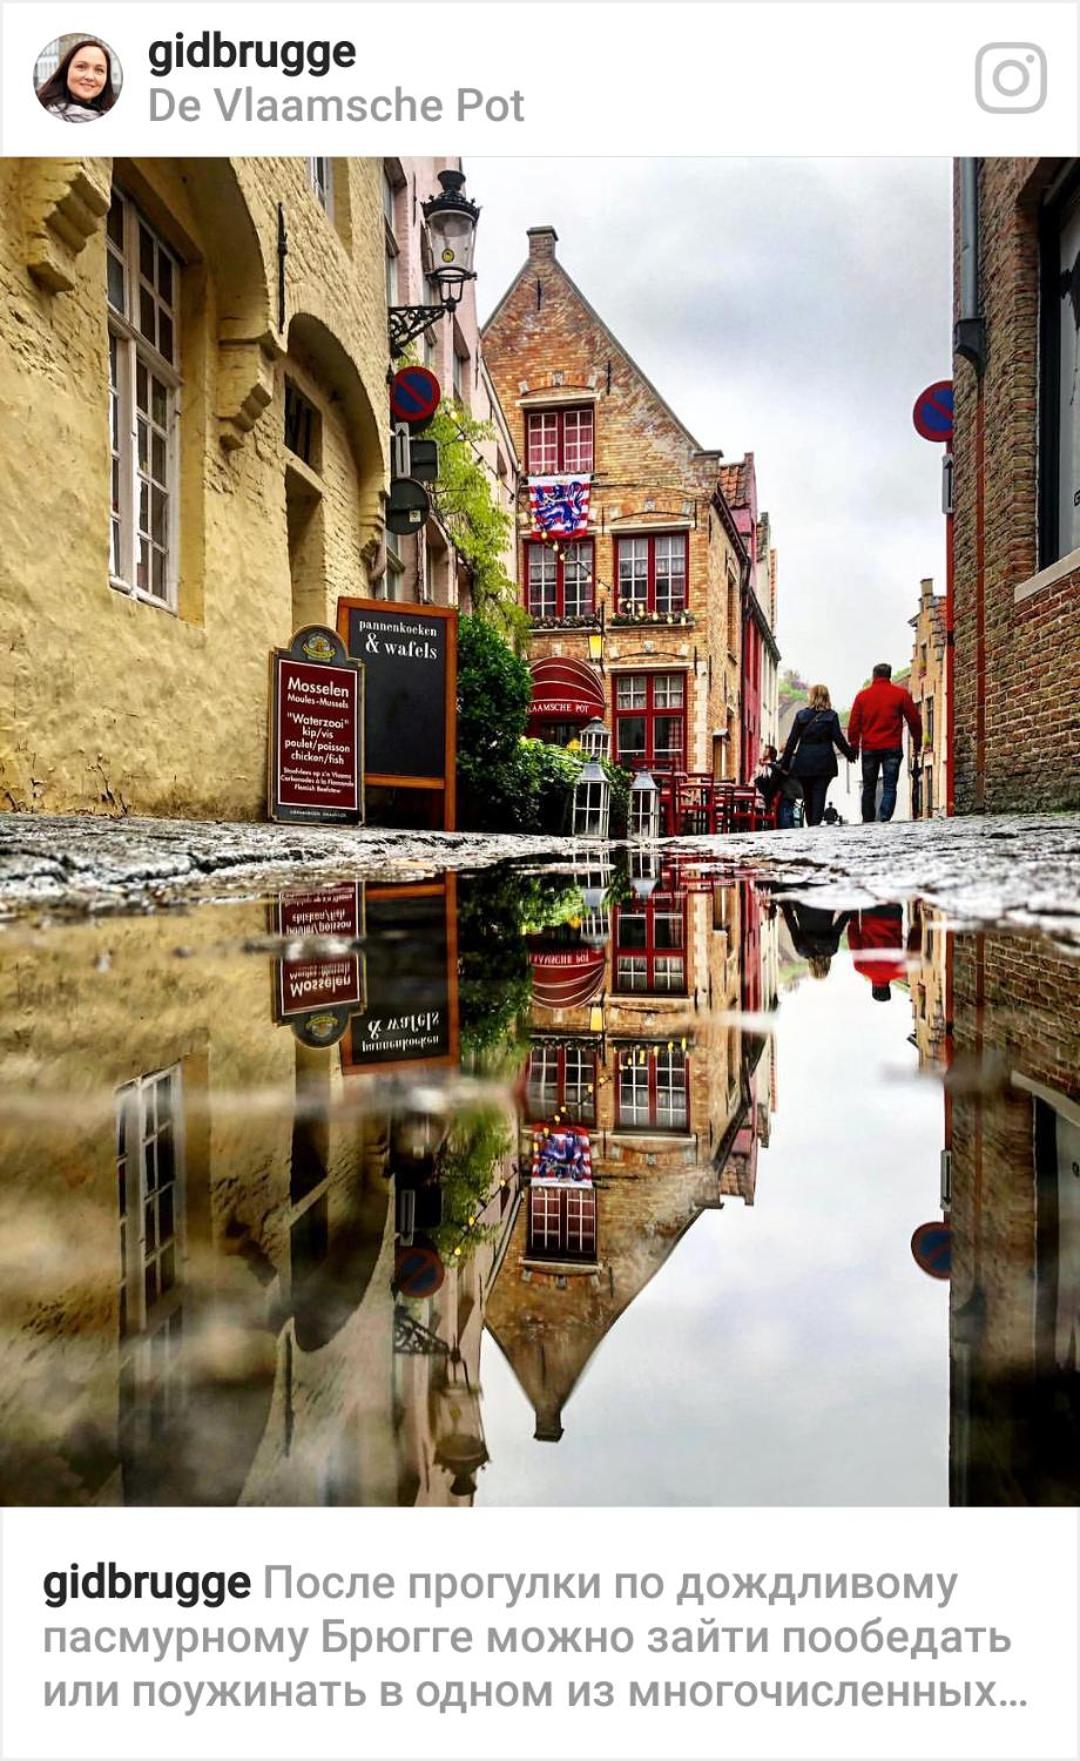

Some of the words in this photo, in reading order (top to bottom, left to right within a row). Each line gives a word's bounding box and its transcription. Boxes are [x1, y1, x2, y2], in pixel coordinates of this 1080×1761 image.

[359, 619, 438, 638] pannenkoeken
[365, 632, 380, 654] &
[384, 640, 438, 660] wafels
[287, 676, 350, 698] Mosselen
[302, 725, 334, 740] kip/vis
[290, 749, 345, 765] chicken/fish
